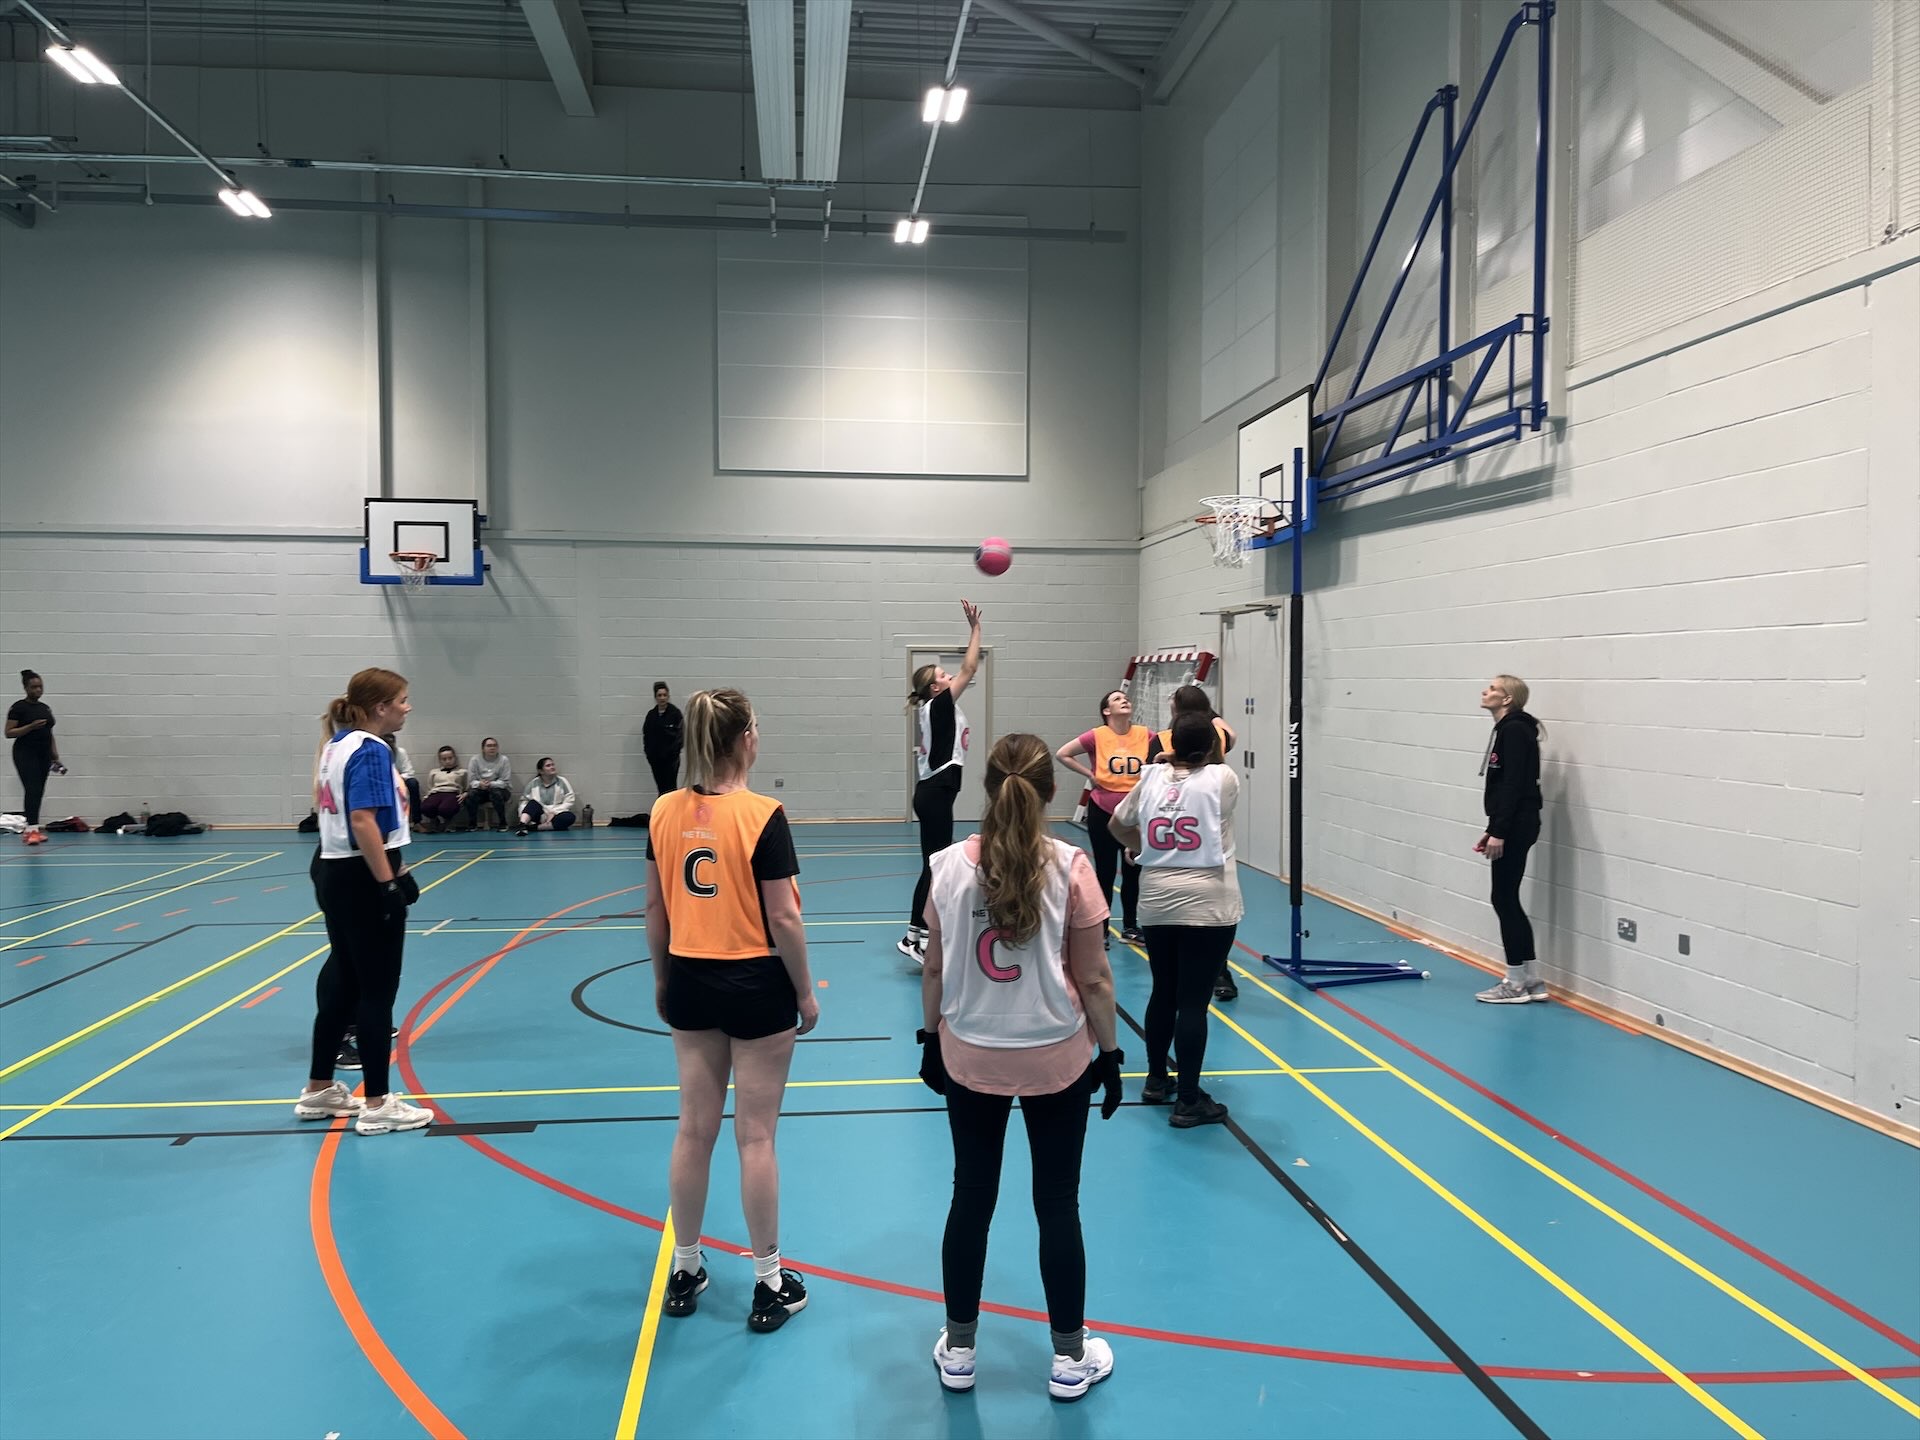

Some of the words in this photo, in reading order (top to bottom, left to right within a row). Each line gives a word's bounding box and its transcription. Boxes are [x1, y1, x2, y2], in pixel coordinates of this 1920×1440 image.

[1108, 755, 1142, 775] GD
[1147, 816, 1202, 851] GS
[682, 847, 718, 898] C
[976, 924, 1021, 983] C
